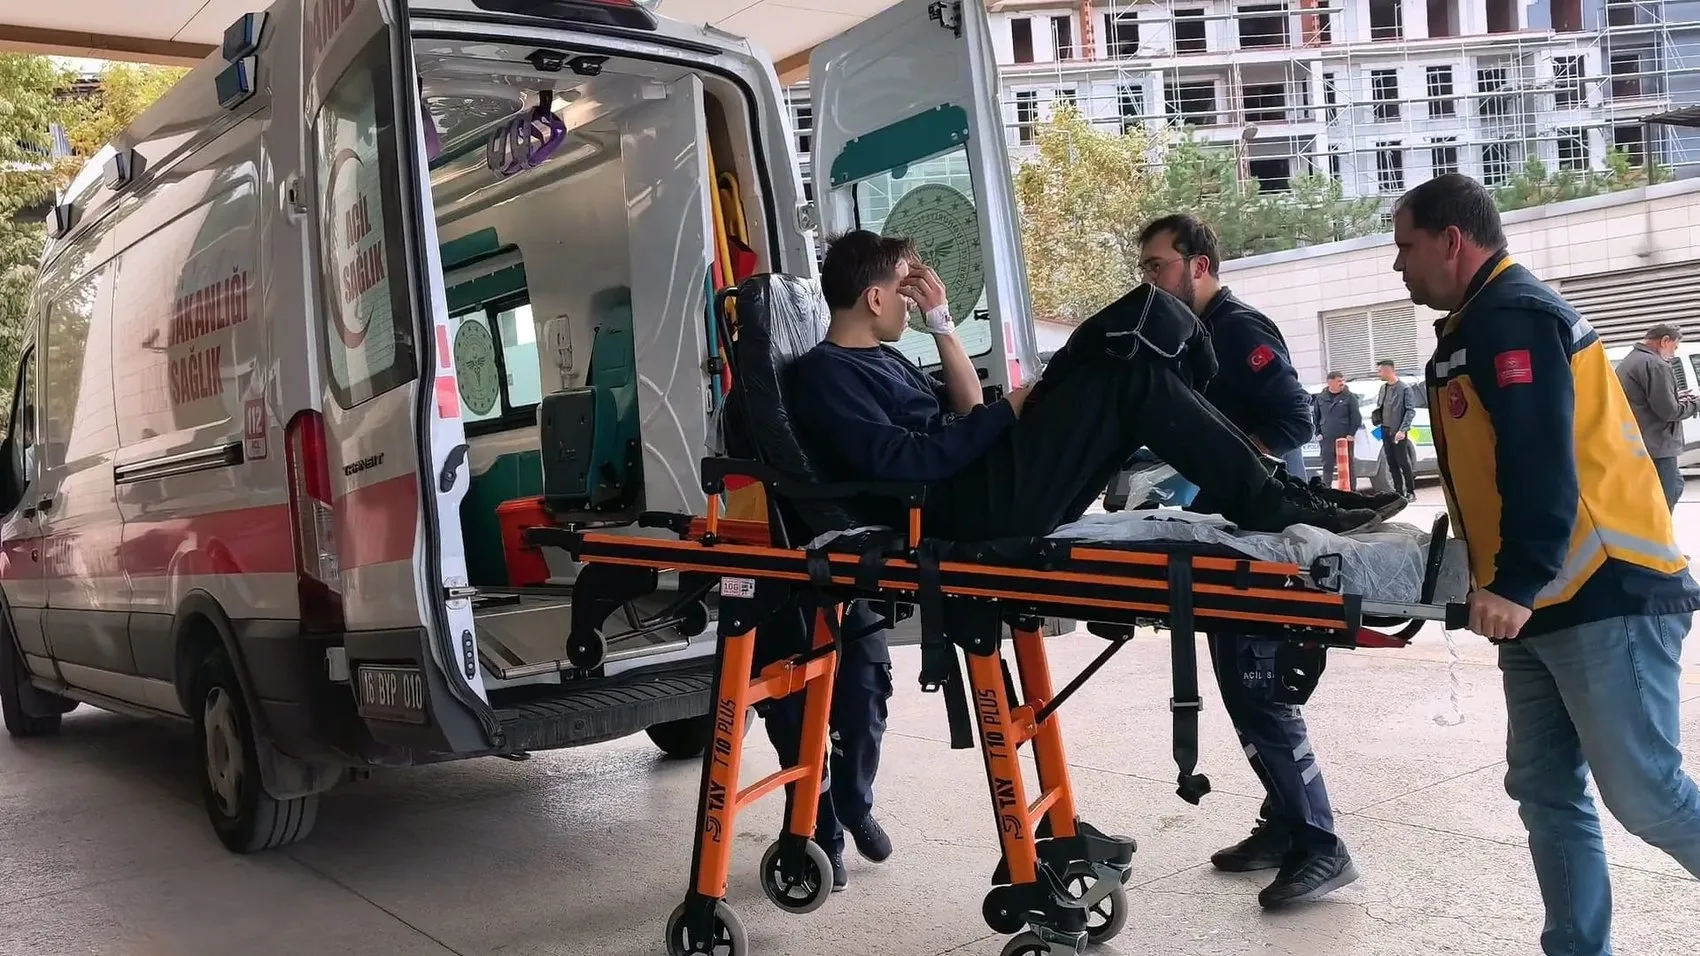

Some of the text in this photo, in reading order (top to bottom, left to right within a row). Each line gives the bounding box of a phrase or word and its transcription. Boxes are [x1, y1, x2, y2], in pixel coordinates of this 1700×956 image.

[345, 192, 372, 250] ACİL
[343, 240, 385, 304] SAĞLIK
[170, 346, 224, 405] SAĞLIK
[248, 406, 262, 435] 112
[364, 672, 422, 709] 16 BYP 010
[979, 689, 1001, 725] PLUS
[708, 780, 726, 811] TAY
[717, 699, 737, 736] PLUS
[998, 778, 1016, 808] TAY
